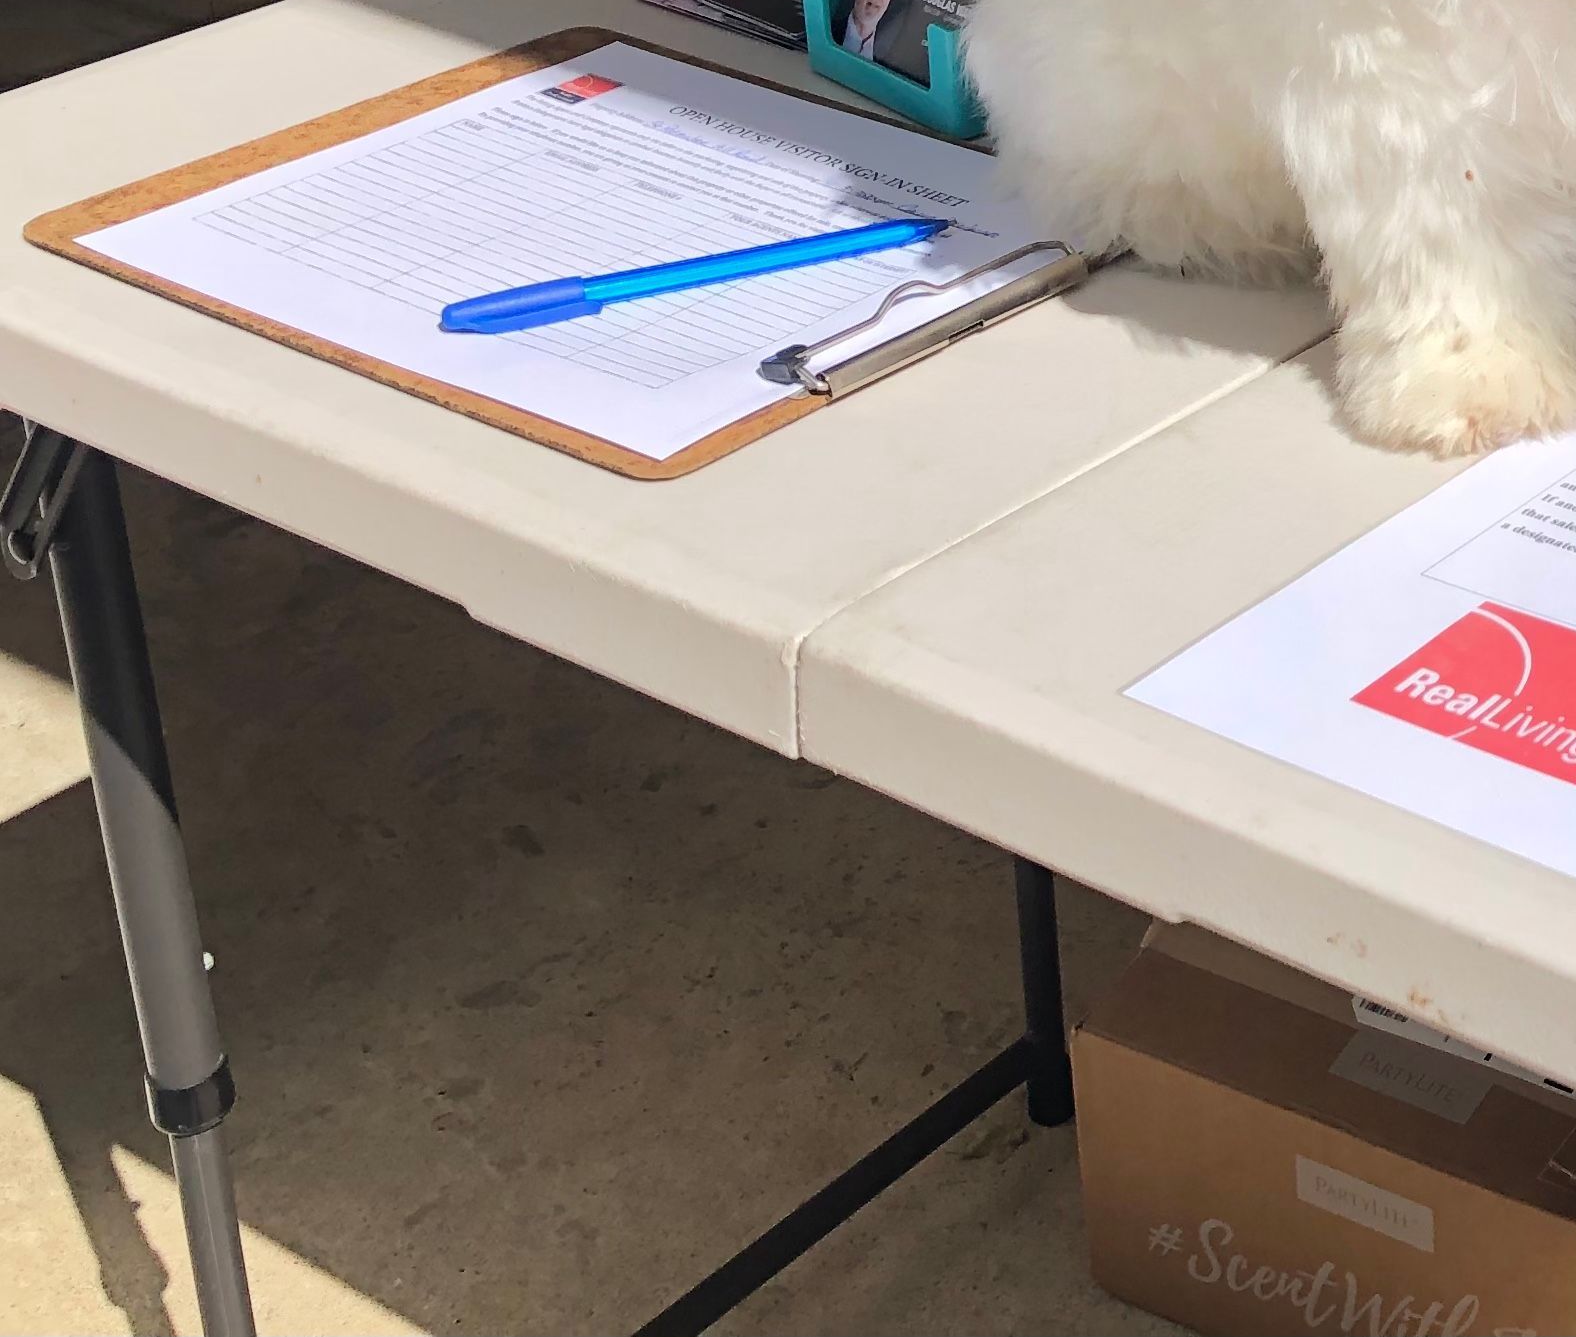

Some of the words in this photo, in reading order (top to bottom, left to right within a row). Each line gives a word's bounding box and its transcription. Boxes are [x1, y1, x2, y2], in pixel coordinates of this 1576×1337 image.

[668, 105, 718, 126] OPEN
[714, 120, 777, 146] HOUSE
[774, 138, 844, 169] VISITOR
[838, 162, 911, 190] SIGN-IN
[905, 183, 970, 209] SHEET
[1541, 493, 1560, 504] If
[1521, 508, 1552, 523] that
[1500, 522, 1511, 530] a
